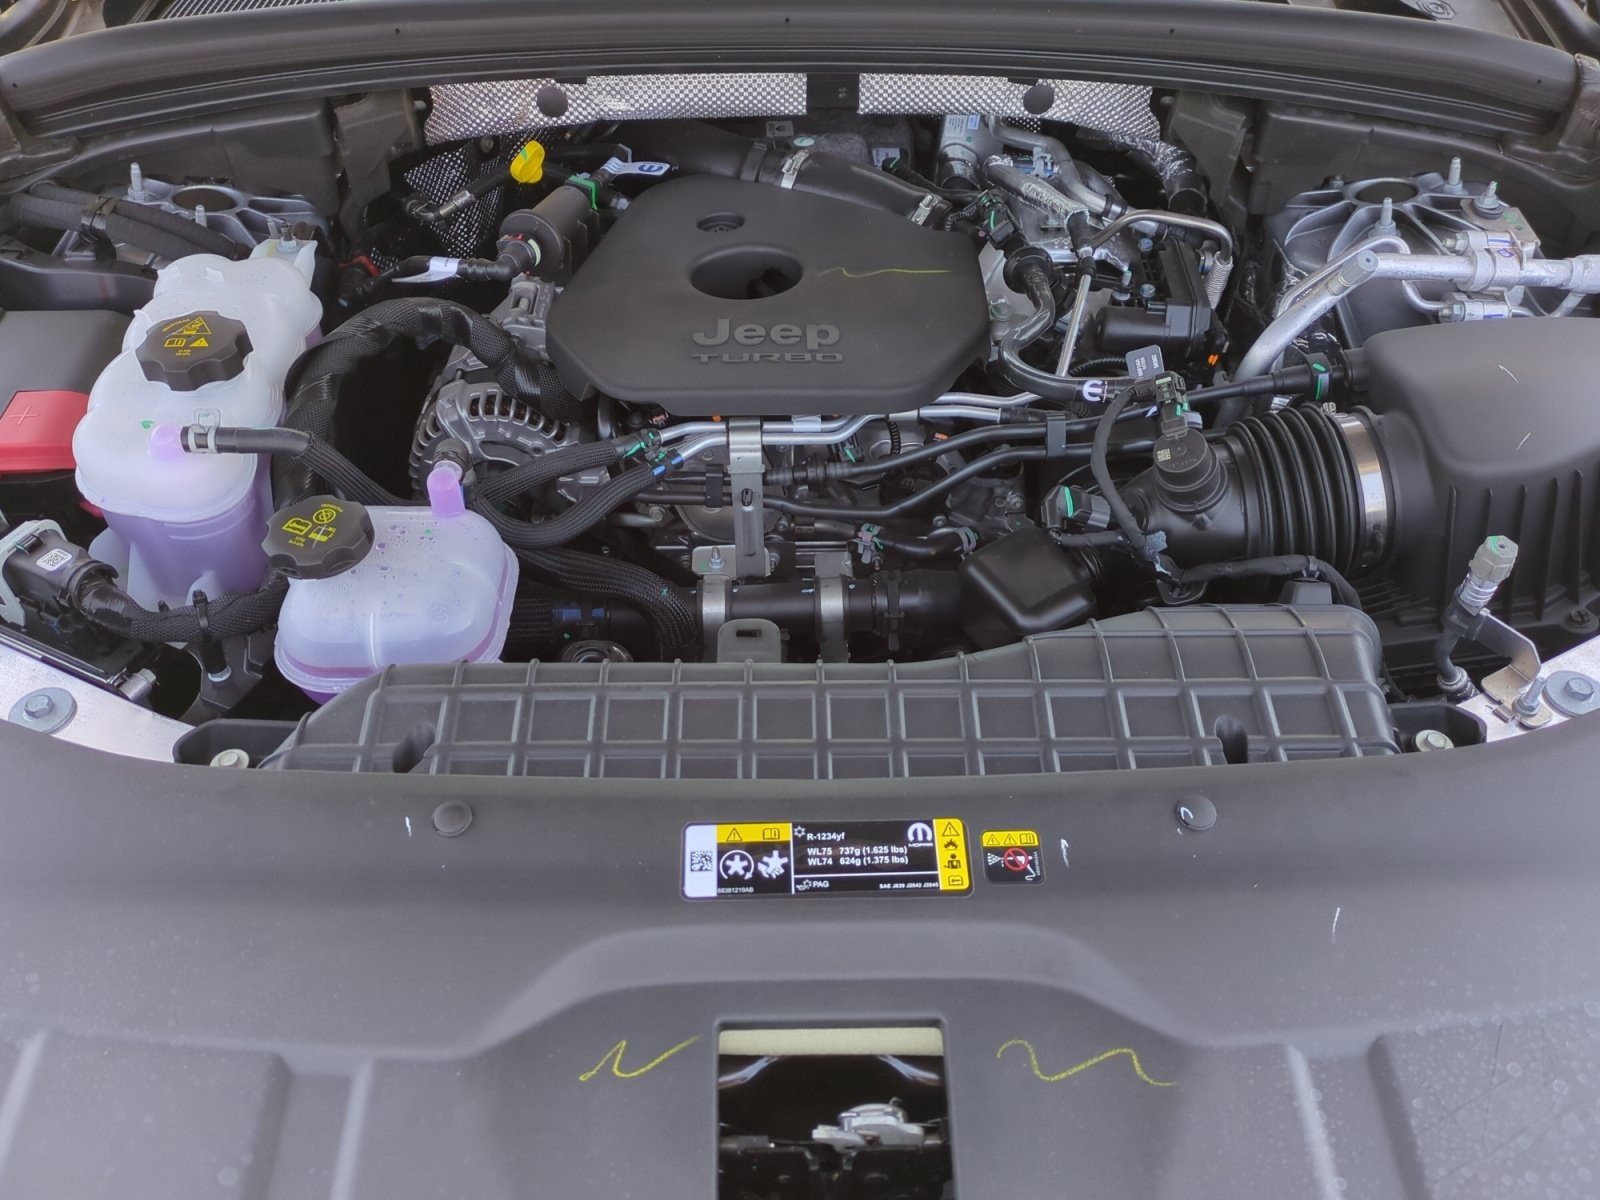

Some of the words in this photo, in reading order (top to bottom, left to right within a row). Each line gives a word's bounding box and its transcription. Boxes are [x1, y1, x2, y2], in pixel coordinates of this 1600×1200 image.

[692, 318, 840, 350] Jeep
[690, 352, 844, 363] TURBO
[806, 832, 845, 841] R-1234yf
[807, 847, 833, 856] WL75
[839, 846, 860, 856] 737g
[862, 846, 889, 856] (1.625
[891, 845, 908, 855] lbs)
[808, 857, 833, 866] WL74
[840, 856, 861, 866] 624g
[863, 856, 890, 866] (1.375
[891, 855, 909, 865] lbs)
